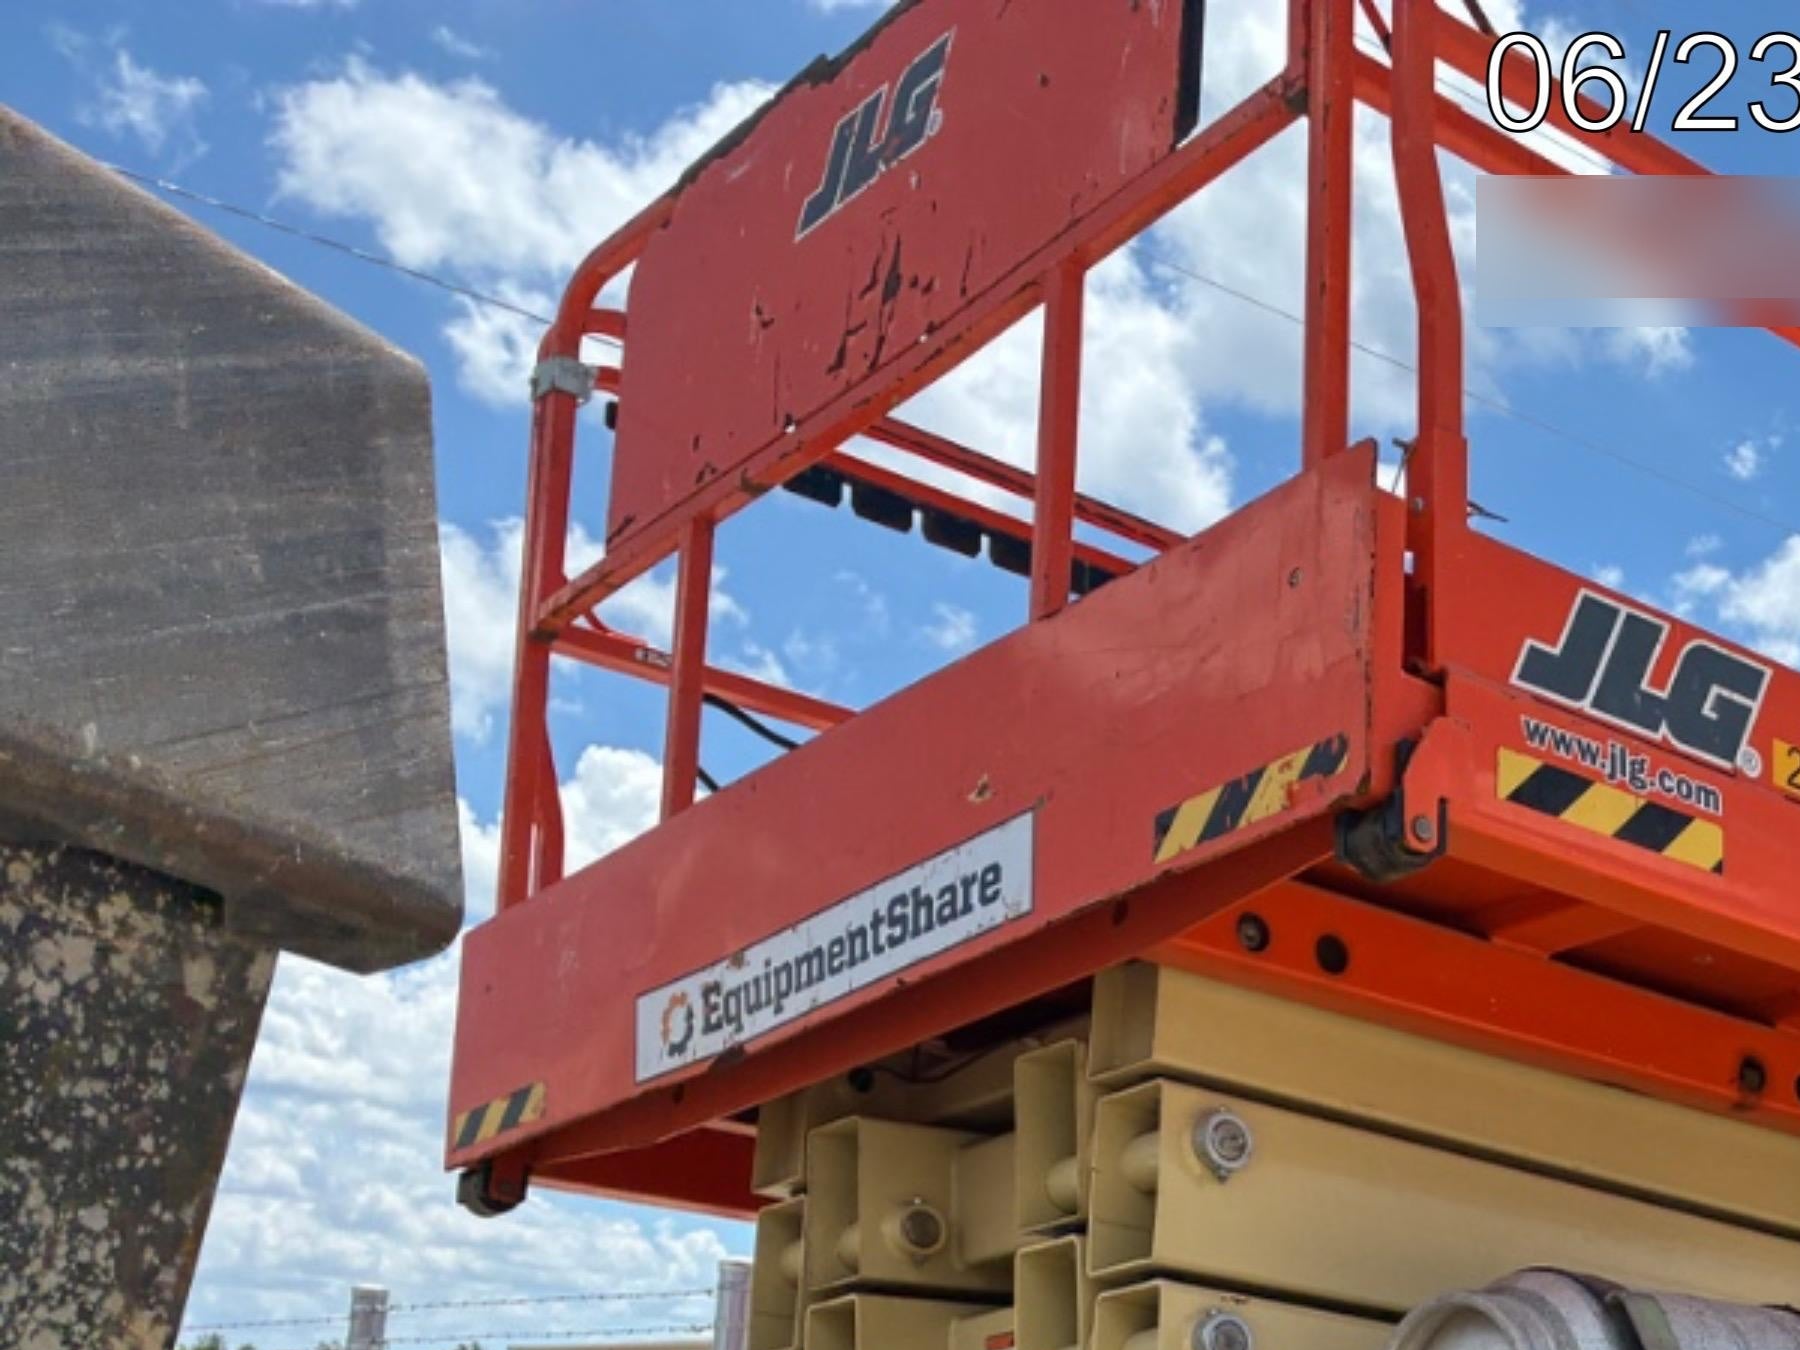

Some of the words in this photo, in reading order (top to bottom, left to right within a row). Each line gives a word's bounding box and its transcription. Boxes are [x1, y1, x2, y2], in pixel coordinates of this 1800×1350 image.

[795, 24, 957, 243] JLG
[1509, 587, 1774, 770] JLG
[1521, 715, 1723, 816] www.jlg.com
[701, 862, 1002, 1036] EquipmentShare
